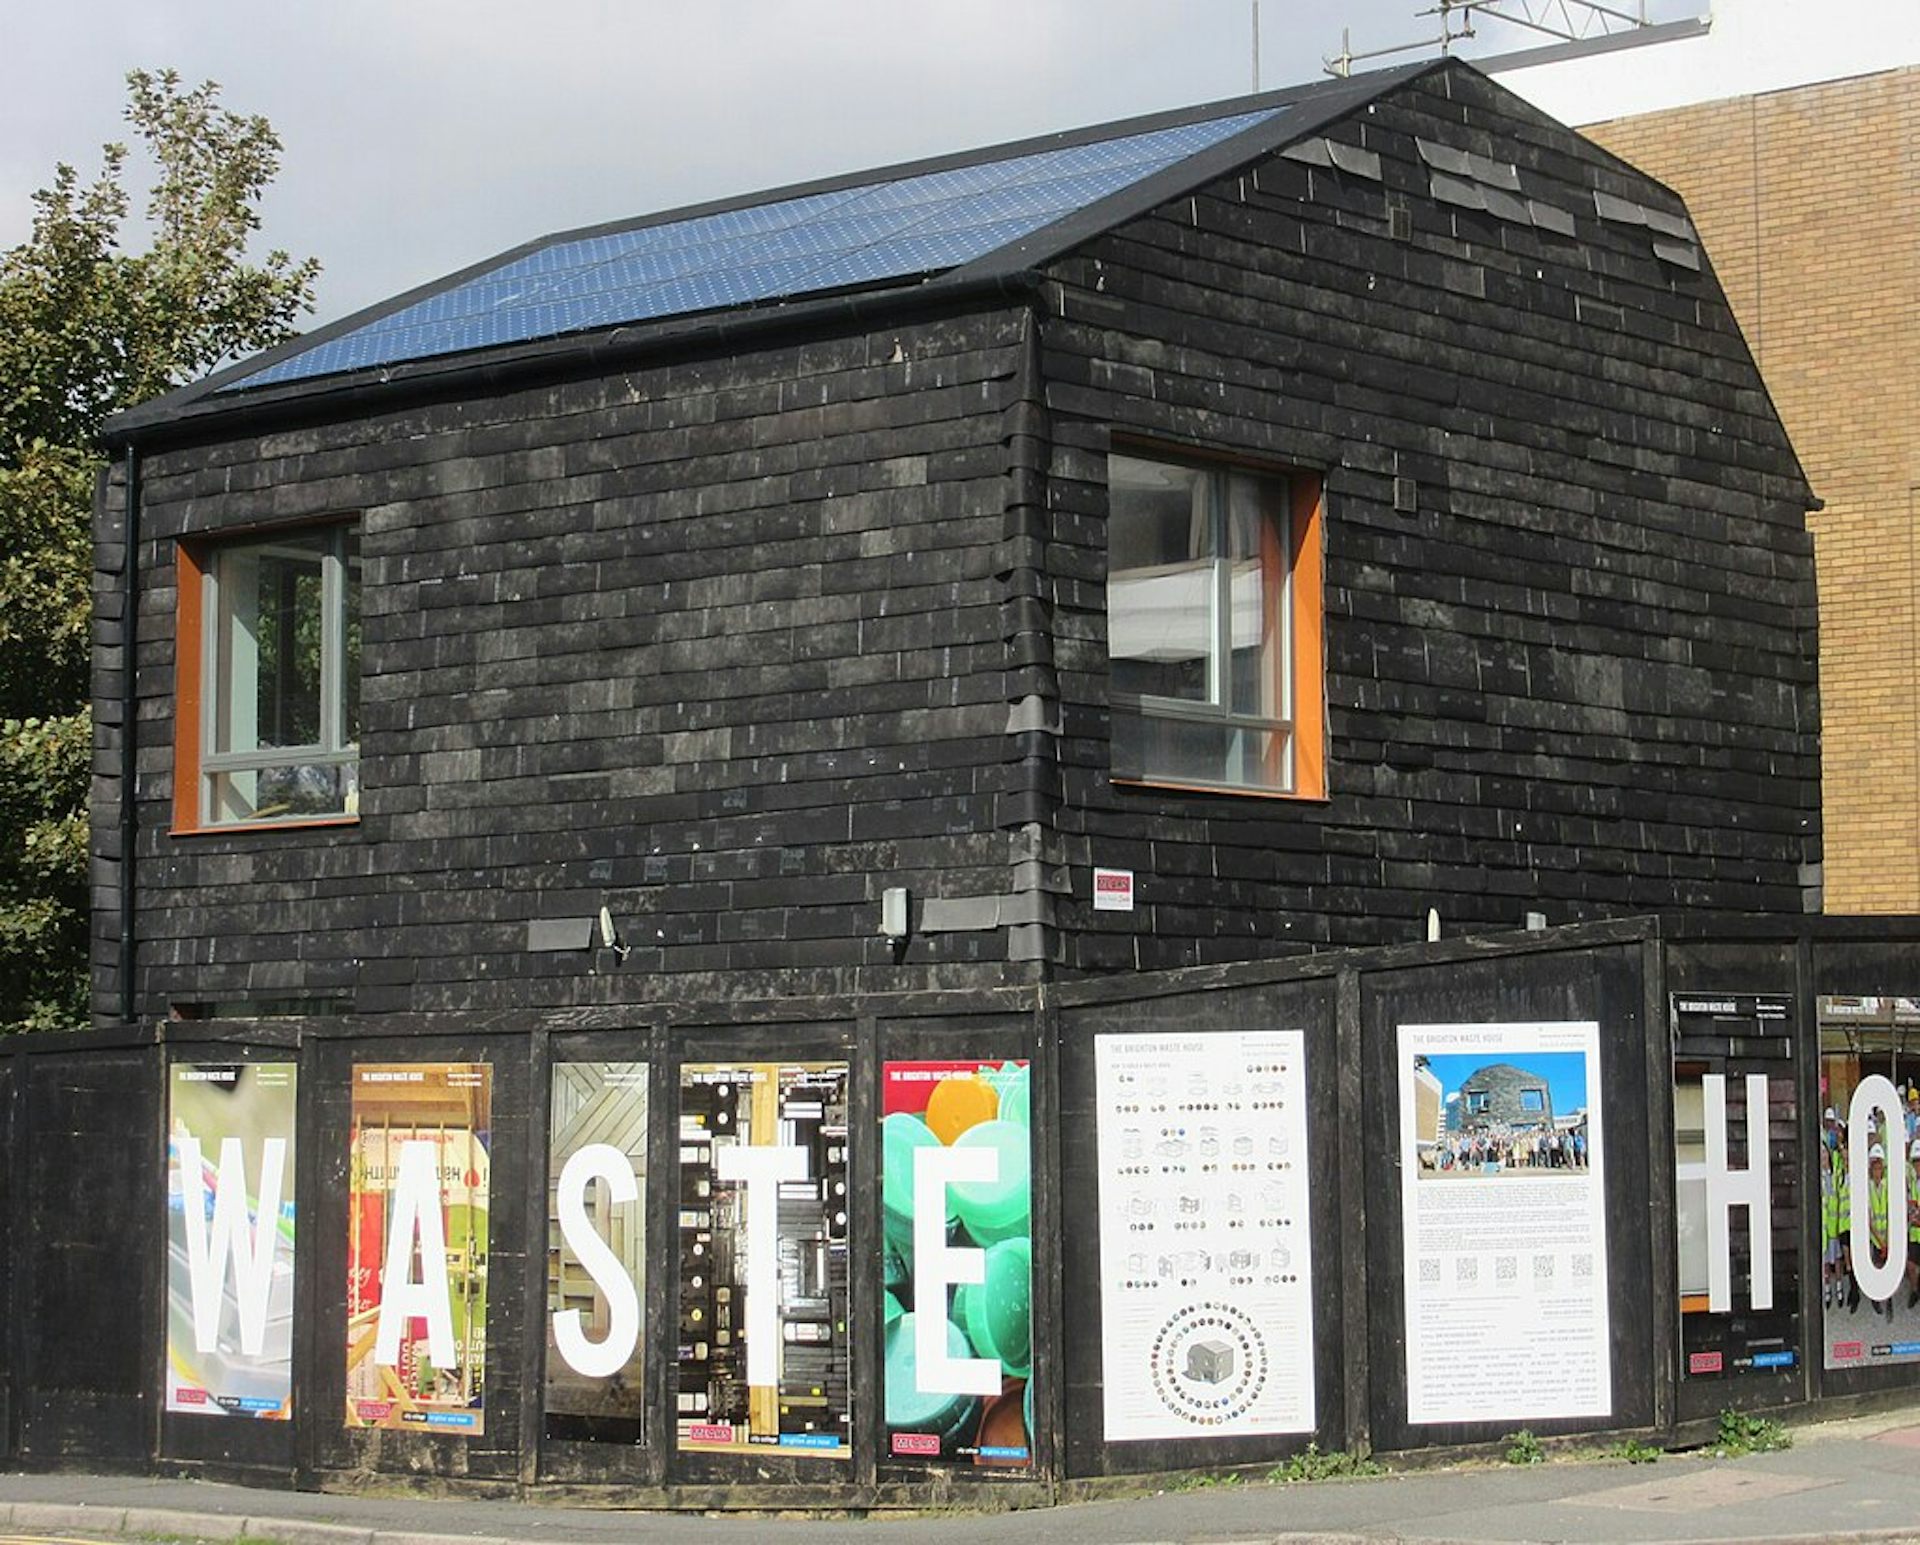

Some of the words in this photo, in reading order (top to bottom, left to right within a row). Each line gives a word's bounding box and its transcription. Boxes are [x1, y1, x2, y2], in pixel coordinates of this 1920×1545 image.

[179, 1137, 286, 1355] W
[374, 1141, 456, 1369] A
[553, 1143, 639, 1377] S
[717, 1145, 808, 1386] T
[914, 1146, 1002, 1396] E
[1702, 1074, 1773, 1313] H
[1848, 1074, 1909, 1301] O
